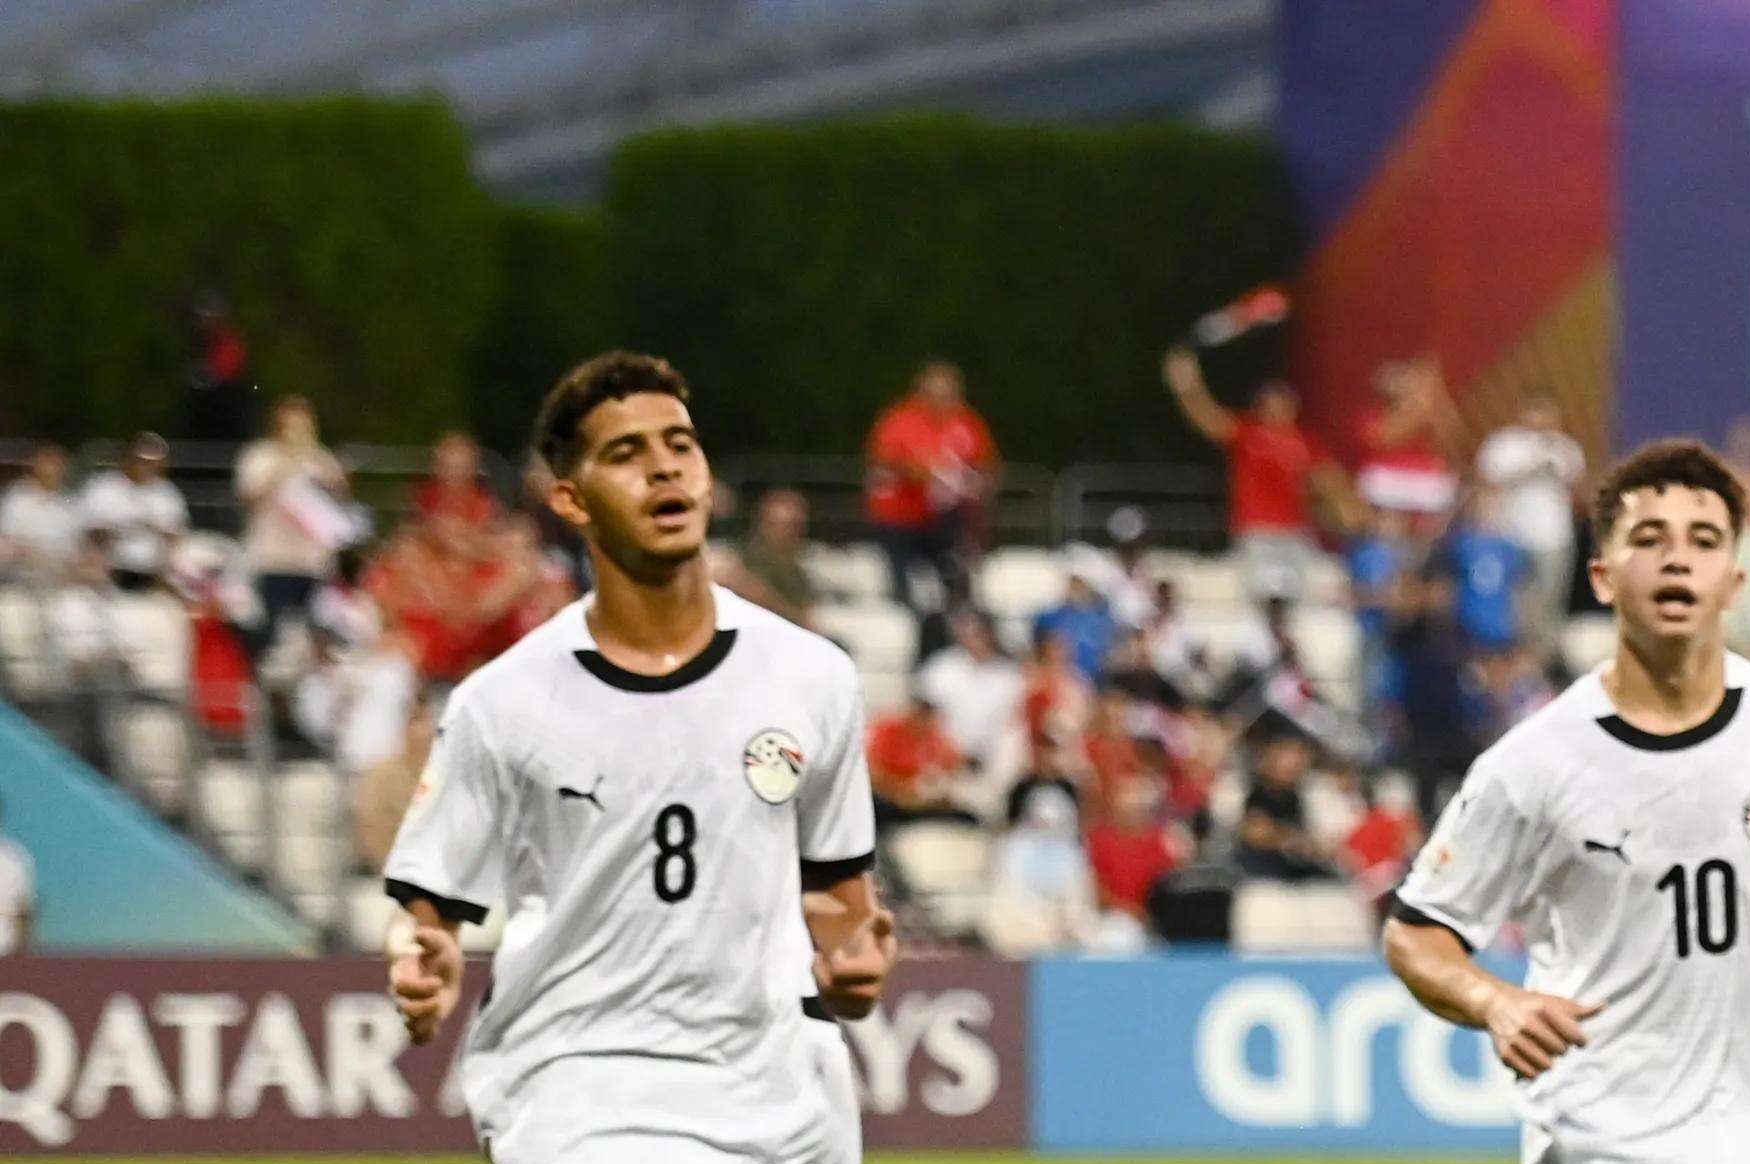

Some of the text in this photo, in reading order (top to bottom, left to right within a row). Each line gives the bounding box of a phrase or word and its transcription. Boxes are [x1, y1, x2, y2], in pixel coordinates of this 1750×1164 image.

[653, 803, 697, 904] 8
[1656, 858, 1737, 959] 10
[0, 990, 416, 1147] QATAR
